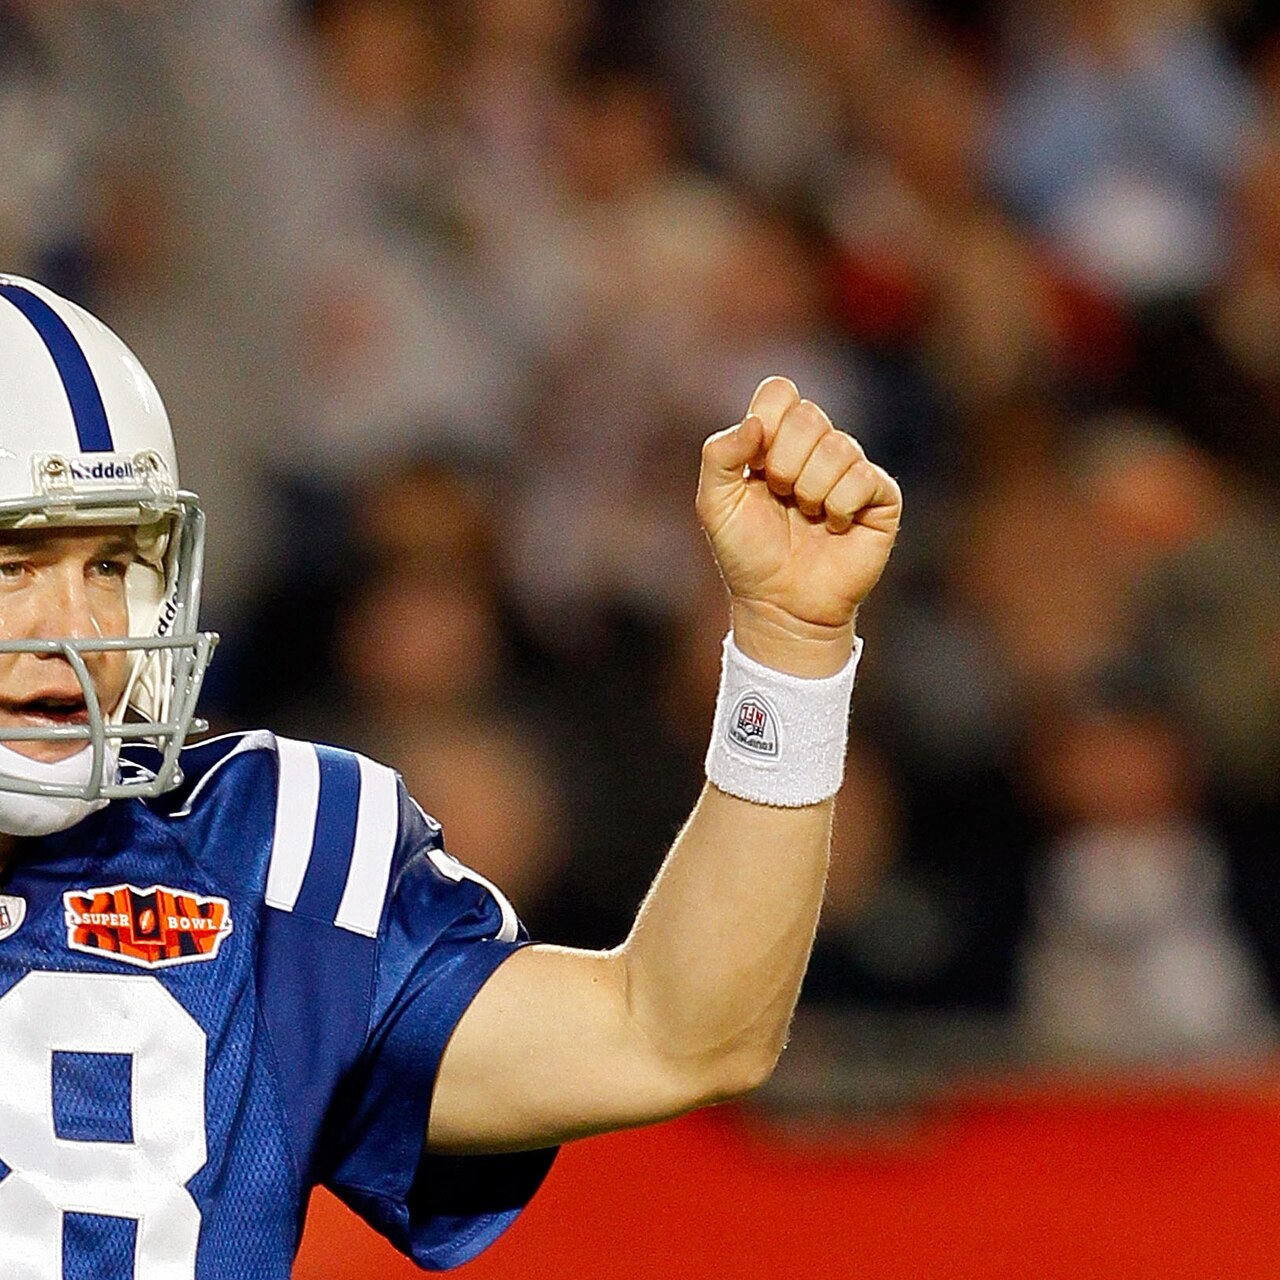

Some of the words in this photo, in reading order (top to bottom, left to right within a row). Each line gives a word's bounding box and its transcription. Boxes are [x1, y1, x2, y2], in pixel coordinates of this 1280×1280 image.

[742, 705, 765, 726] NFL
[82, 913, 131, 927] SUPER
[167, 916, 217, 931] BOWL
